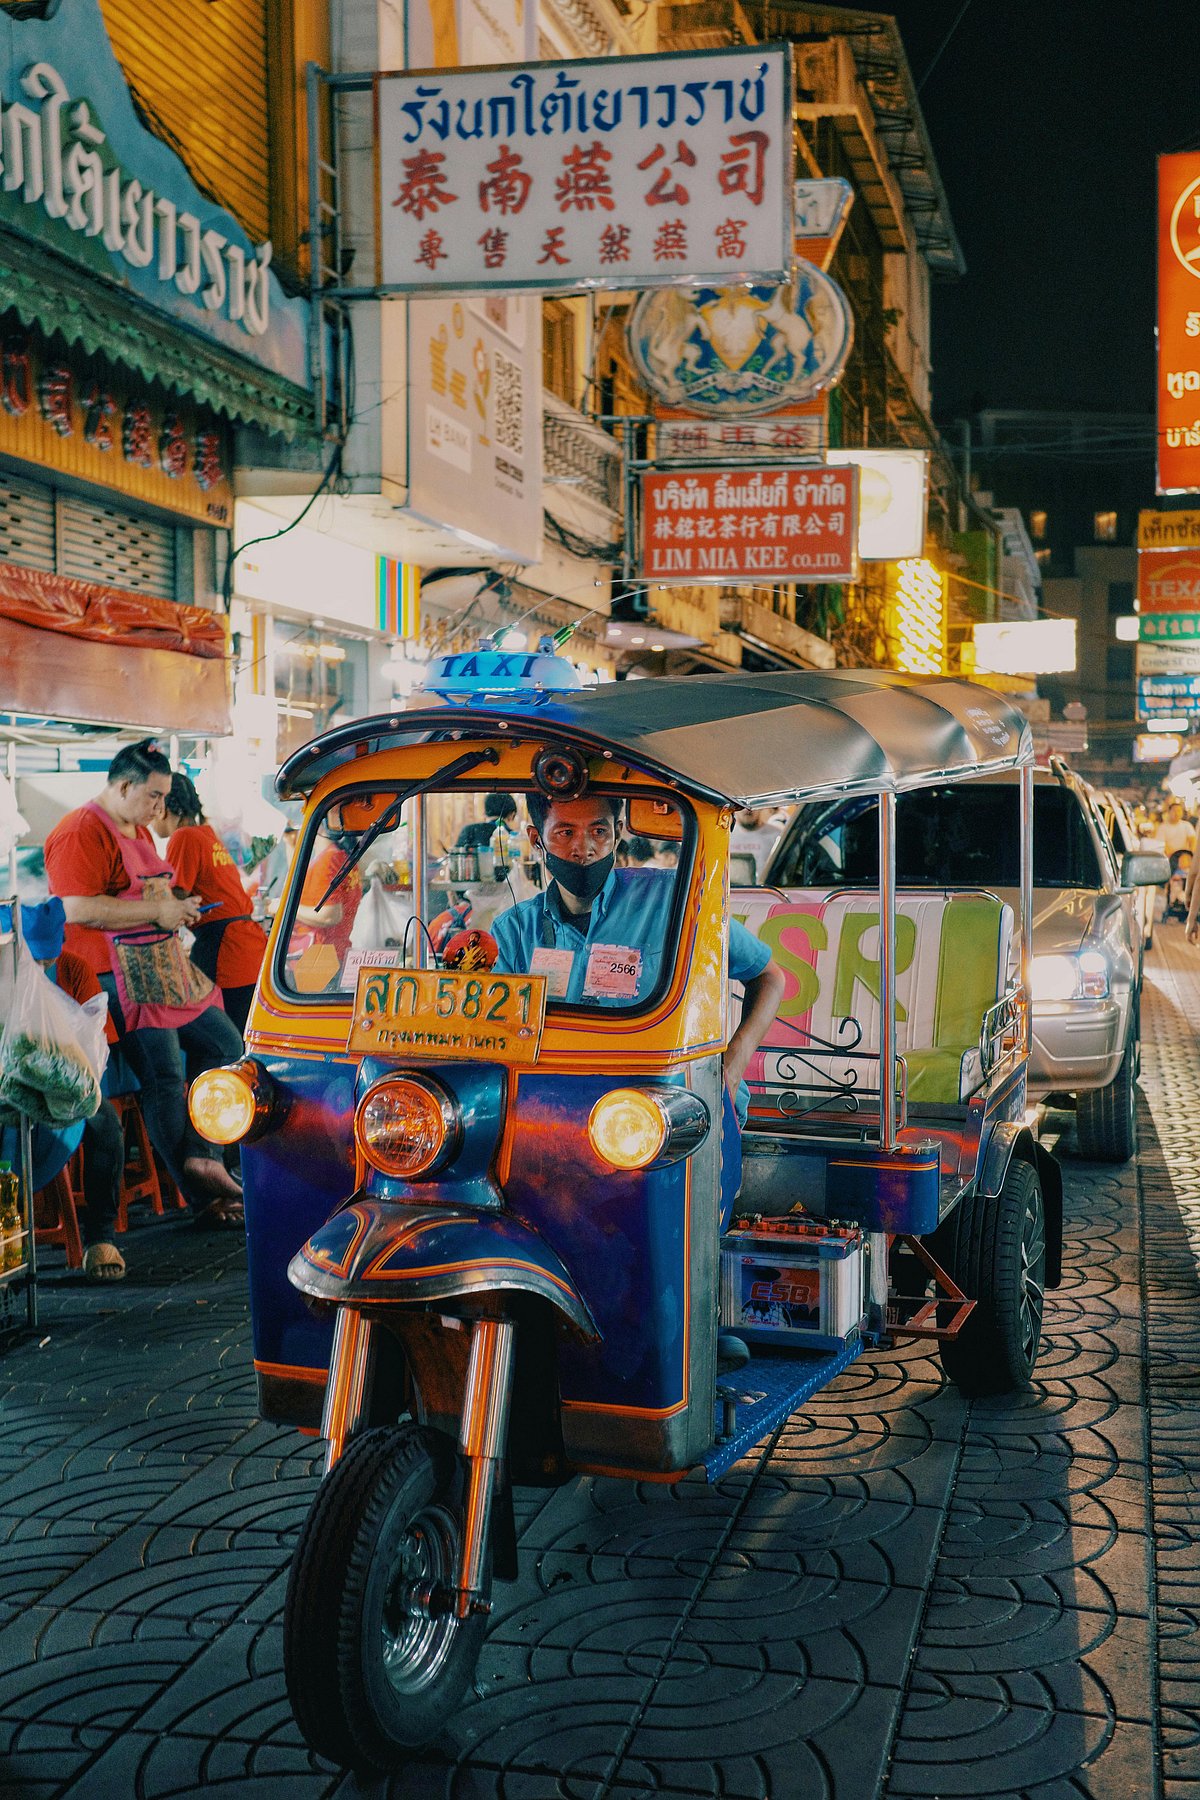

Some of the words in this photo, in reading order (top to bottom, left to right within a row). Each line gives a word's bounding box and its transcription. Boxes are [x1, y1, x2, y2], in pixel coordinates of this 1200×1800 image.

[400, 62, 769, 143] รังนกใต้เยาวราช
[392, 130, 770, 221] 泰南燕公司
[652, 478, 709, 511] บริษัท
[793, 474, 847, 507] จำกัด
[653, 511, 846, 540] 林銘記茶行有限公司
[652, 549, 692, 571] LIM
[698, 547, 738, 570] MIA
[744, 546, 788, 569] KEE
[440, 654, 538, 678] TAXI
[609, 963, 637, 976] 2566
[435, 977, 533, 1025] 5821
[376, 1029, 507, 1050] กรุงเทพมหานคร
